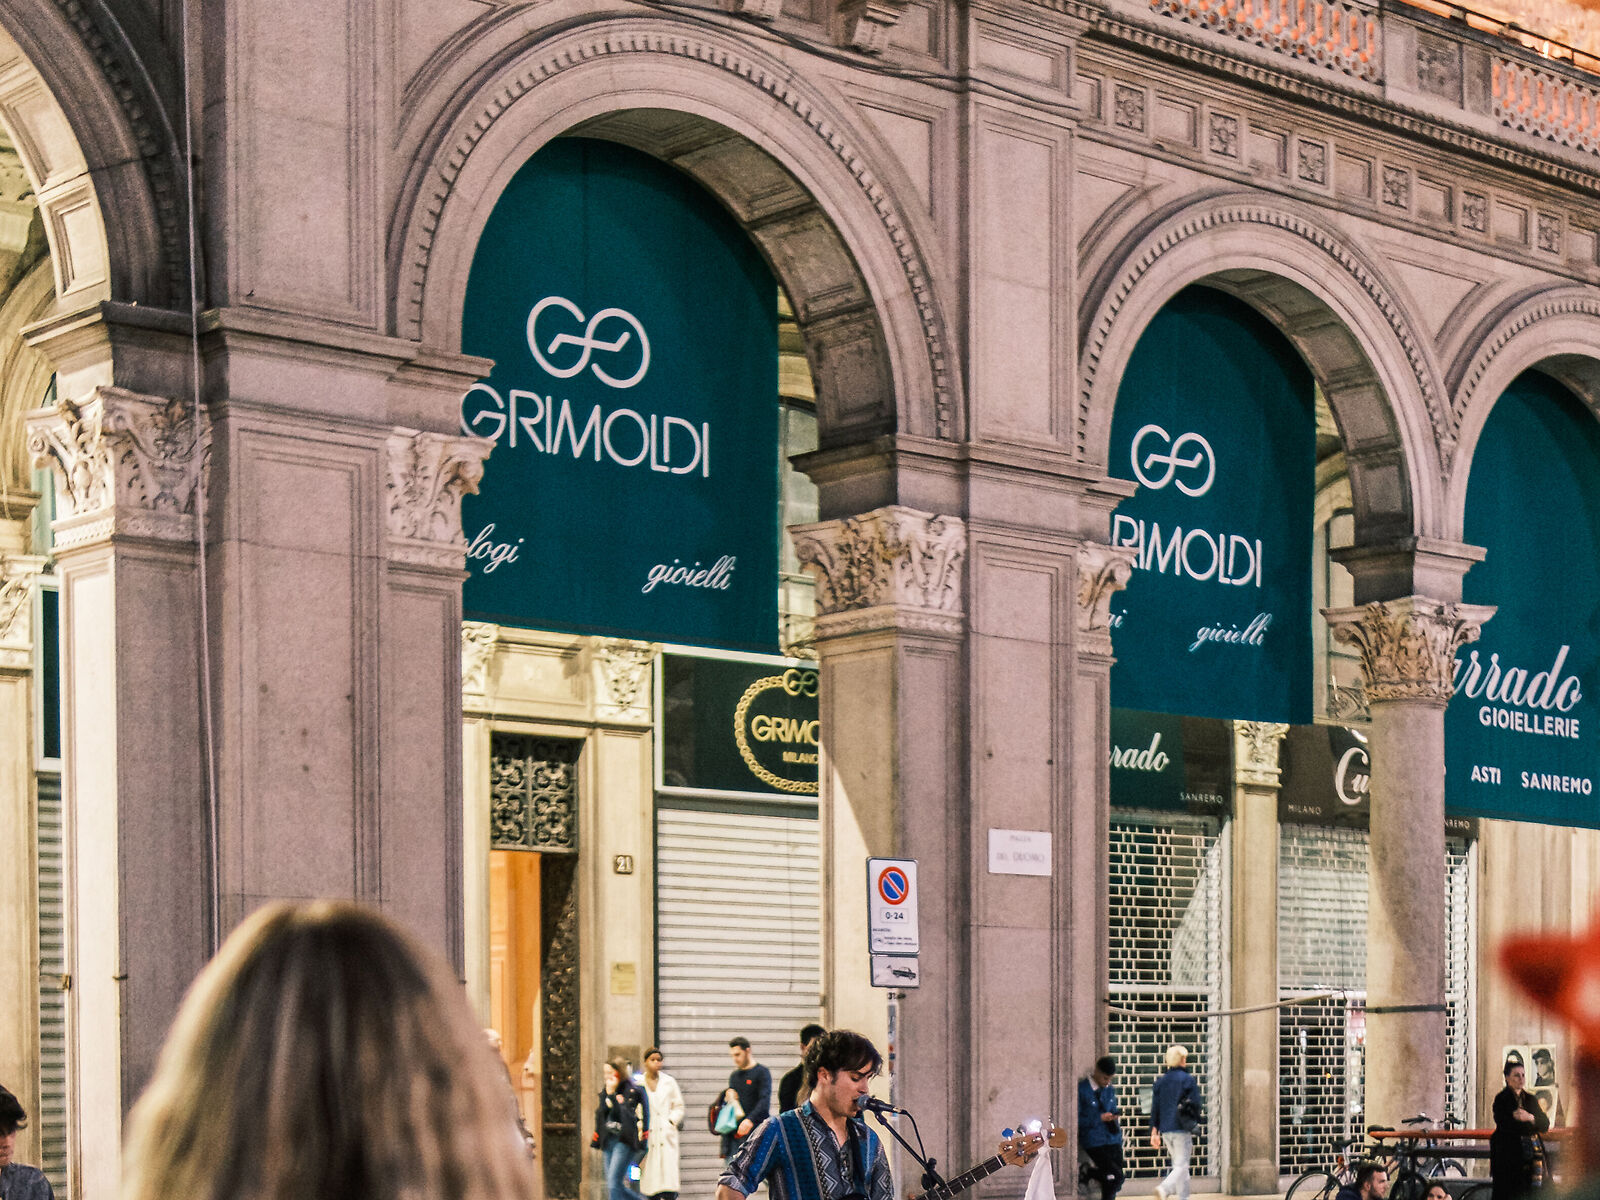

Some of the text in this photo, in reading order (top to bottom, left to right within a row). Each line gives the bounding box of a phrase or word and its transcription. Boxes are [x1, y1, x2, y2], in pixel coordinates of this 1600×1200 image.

[460, 383, 710, 478] GRIMOLDI
[464, 523, 737, 594] logi gioielli
[1112, 514, 1263, 588] RIMOLDI
[1189, 612, 1272, 652] gioielli
[1453, 644, 1583, 712] rrado
[1479, 705, 1580, 739] GIOIELLERIE
[1110, 732, 1170, 772] rado
[1180, 791, 1223, 804] SANREMO
[1470, 765, 1593, 796] ASTI SANREMO
[616, 856, 631, 872] 21
[885, 911, 904, 920] 0-24
